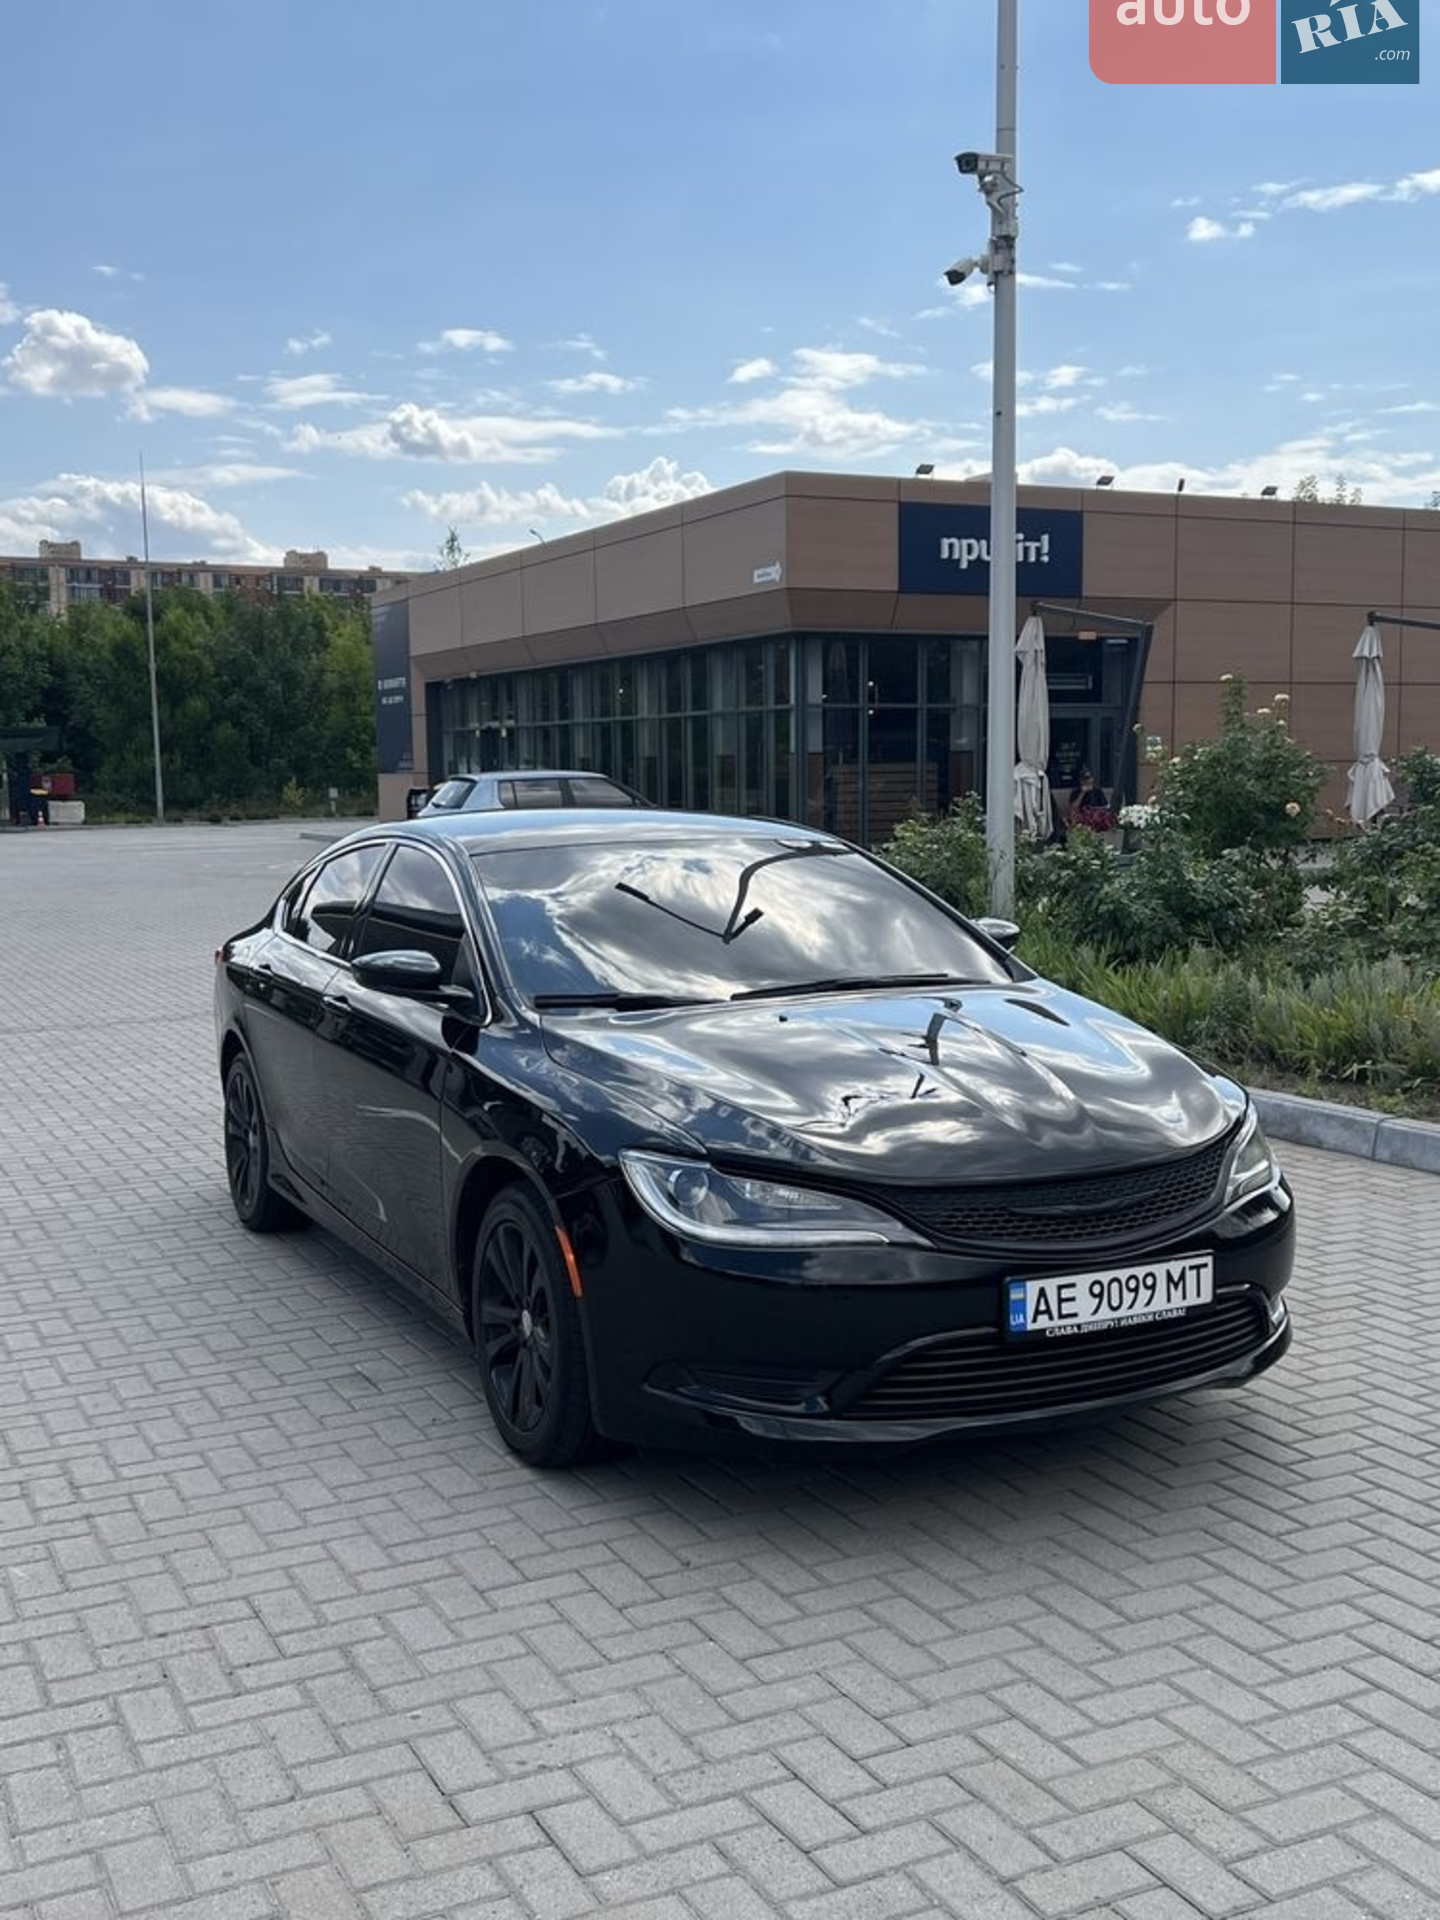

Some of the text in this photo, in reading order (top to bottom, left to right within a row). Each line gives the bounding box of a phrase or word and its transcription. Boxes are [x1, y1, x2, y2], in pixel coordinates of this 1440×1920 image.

[940, 532, 1049, 570] приіт!
[1031, 1262, 1209, 1324] AE 9099 MT
[1010, 1312, 1026, 1326] UA
